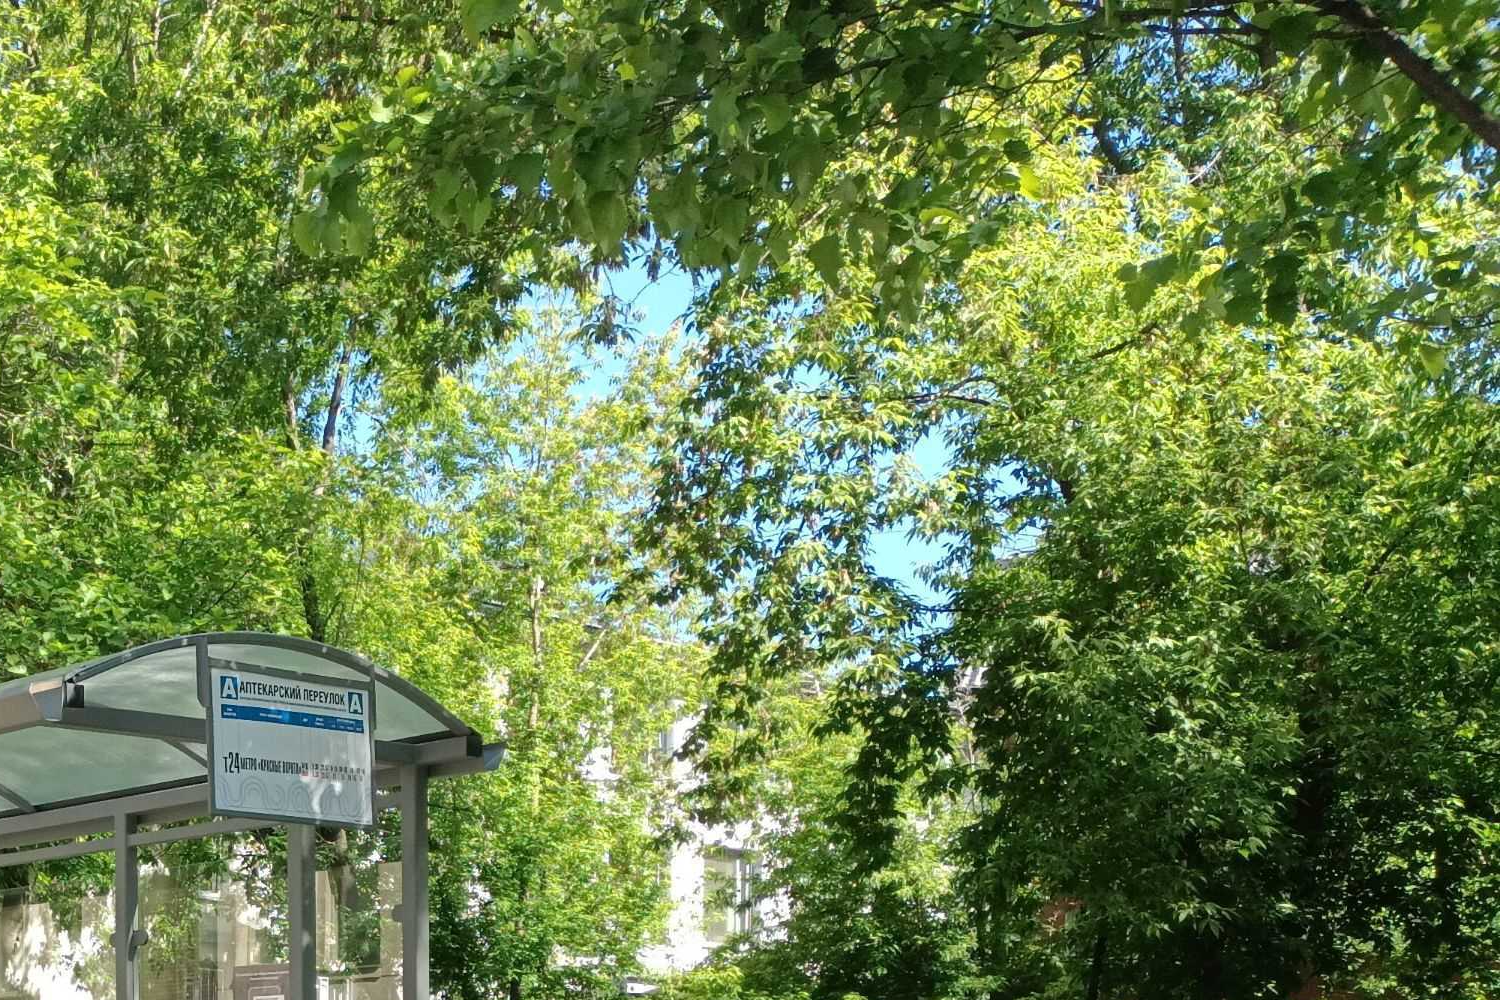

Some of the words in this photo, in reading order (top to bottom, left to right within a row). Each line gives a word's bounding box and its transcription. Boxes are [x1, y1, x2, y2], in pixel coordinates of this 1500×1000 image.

[240, 681, 301, 701] АПТЕКАРСКИЙ
[303, 688, 346, 706] ПЕРЕУЛОК
[240, 757, 257, 771] МЕТРО
